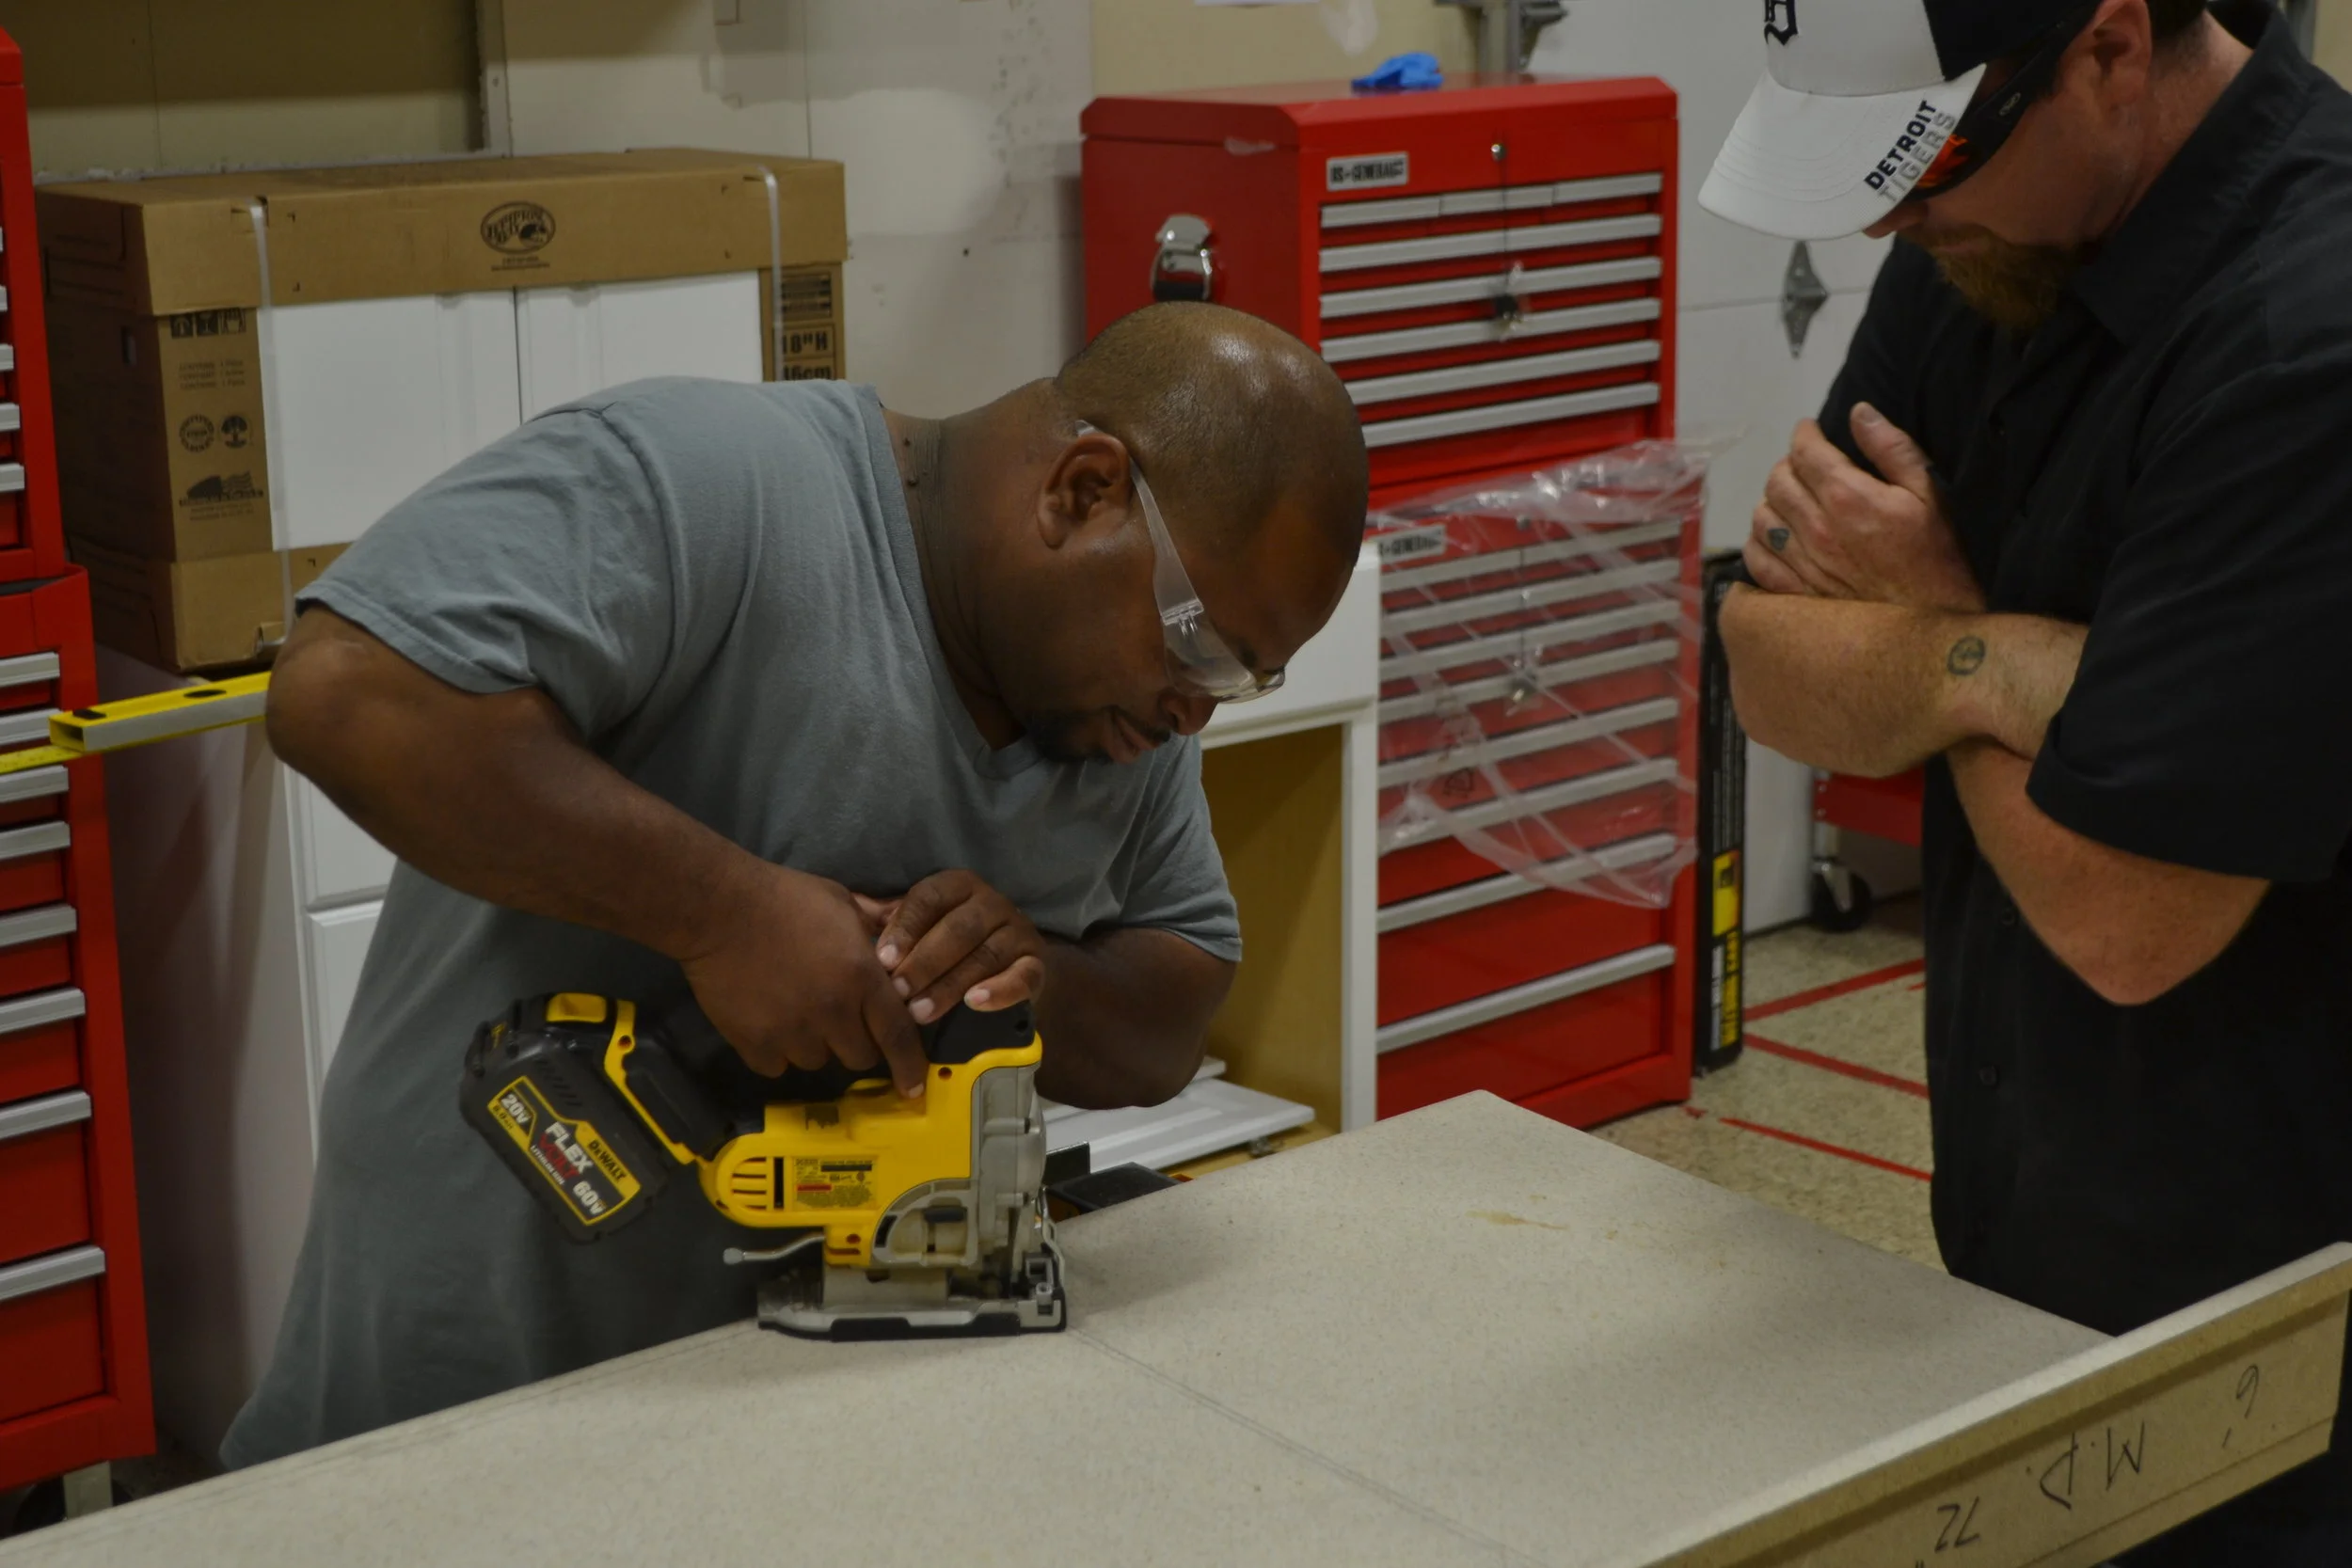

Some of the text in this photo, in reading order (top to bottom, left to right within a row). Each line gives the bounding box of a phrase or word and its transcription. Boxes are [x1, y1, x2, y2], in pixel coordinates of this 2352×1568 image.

[1864, 99, 1937, 191] DETROIT
[1877, 111, 1957, 203] TIGERS
[538, 1132, 581, 1180] VOLT
[544, 1120, 595, 1175] FLEX
[572, 1180, 607, 1216] 60V
